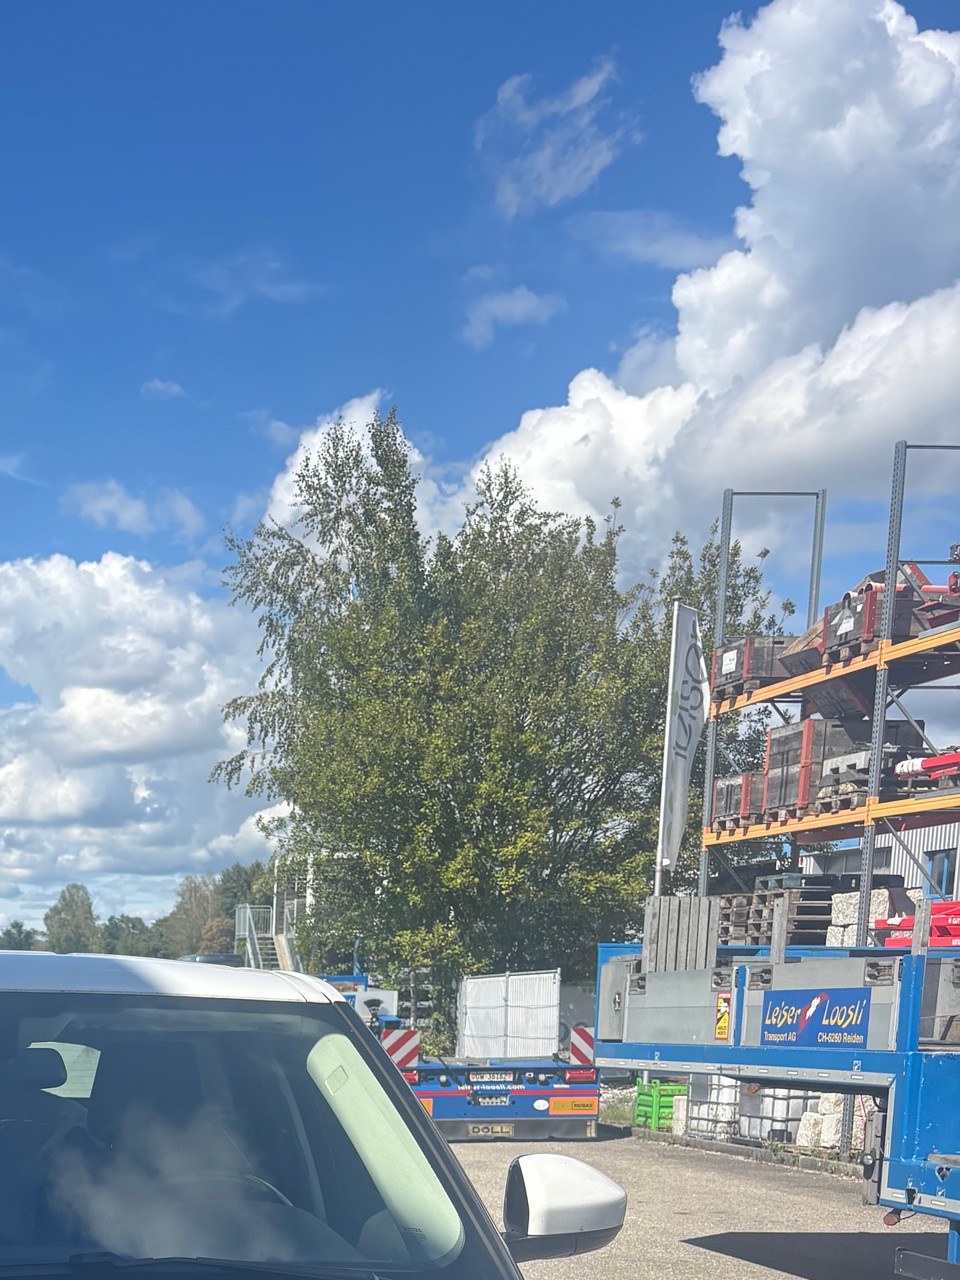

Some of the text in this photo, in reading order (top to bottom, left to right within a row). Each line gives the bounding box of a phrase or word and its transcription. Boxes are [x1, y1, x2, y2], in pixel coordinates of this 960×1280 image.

[765, 999, 867, 1029] Leiser Loosli
[763, 1032, 796, 1043] Transport AG
[842, 1033, 864, 1044] Reiden
[472, 1126, 510, 1134] DOLL
